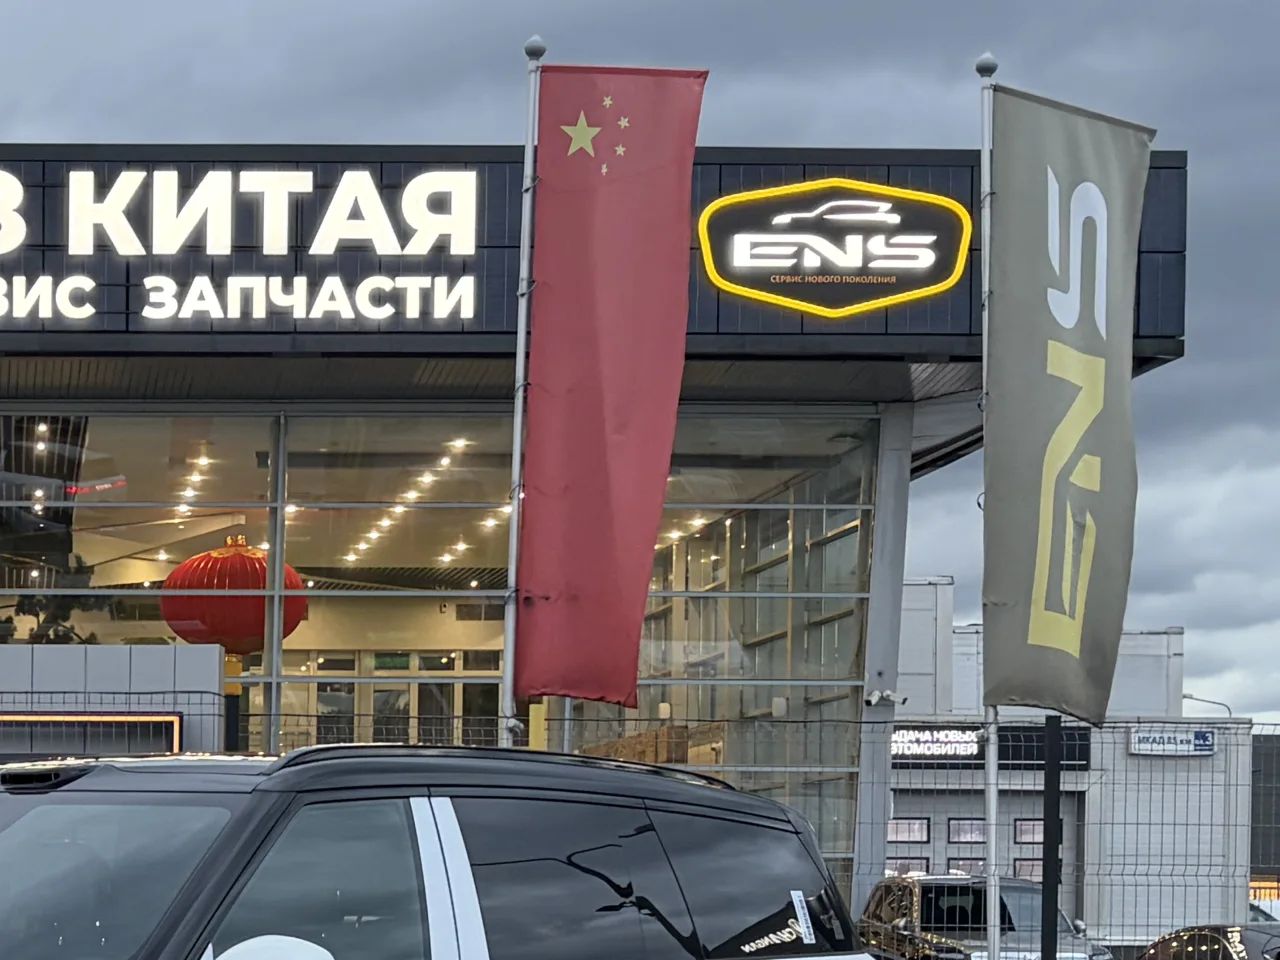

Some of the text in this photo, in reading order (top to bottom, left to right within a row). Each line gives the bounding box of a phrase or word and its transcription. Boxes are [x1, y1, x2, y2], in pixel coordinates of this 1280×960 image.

[67, 169, 478, 257] КИТАЯ
[732, 233, 938, 268] ENS
[140, 275, 475, 320] ЗАПЧАСТИ
[770, 275, 896, 284] СЕРВИС НОВОГО ПОКОЛЕНИЯ
